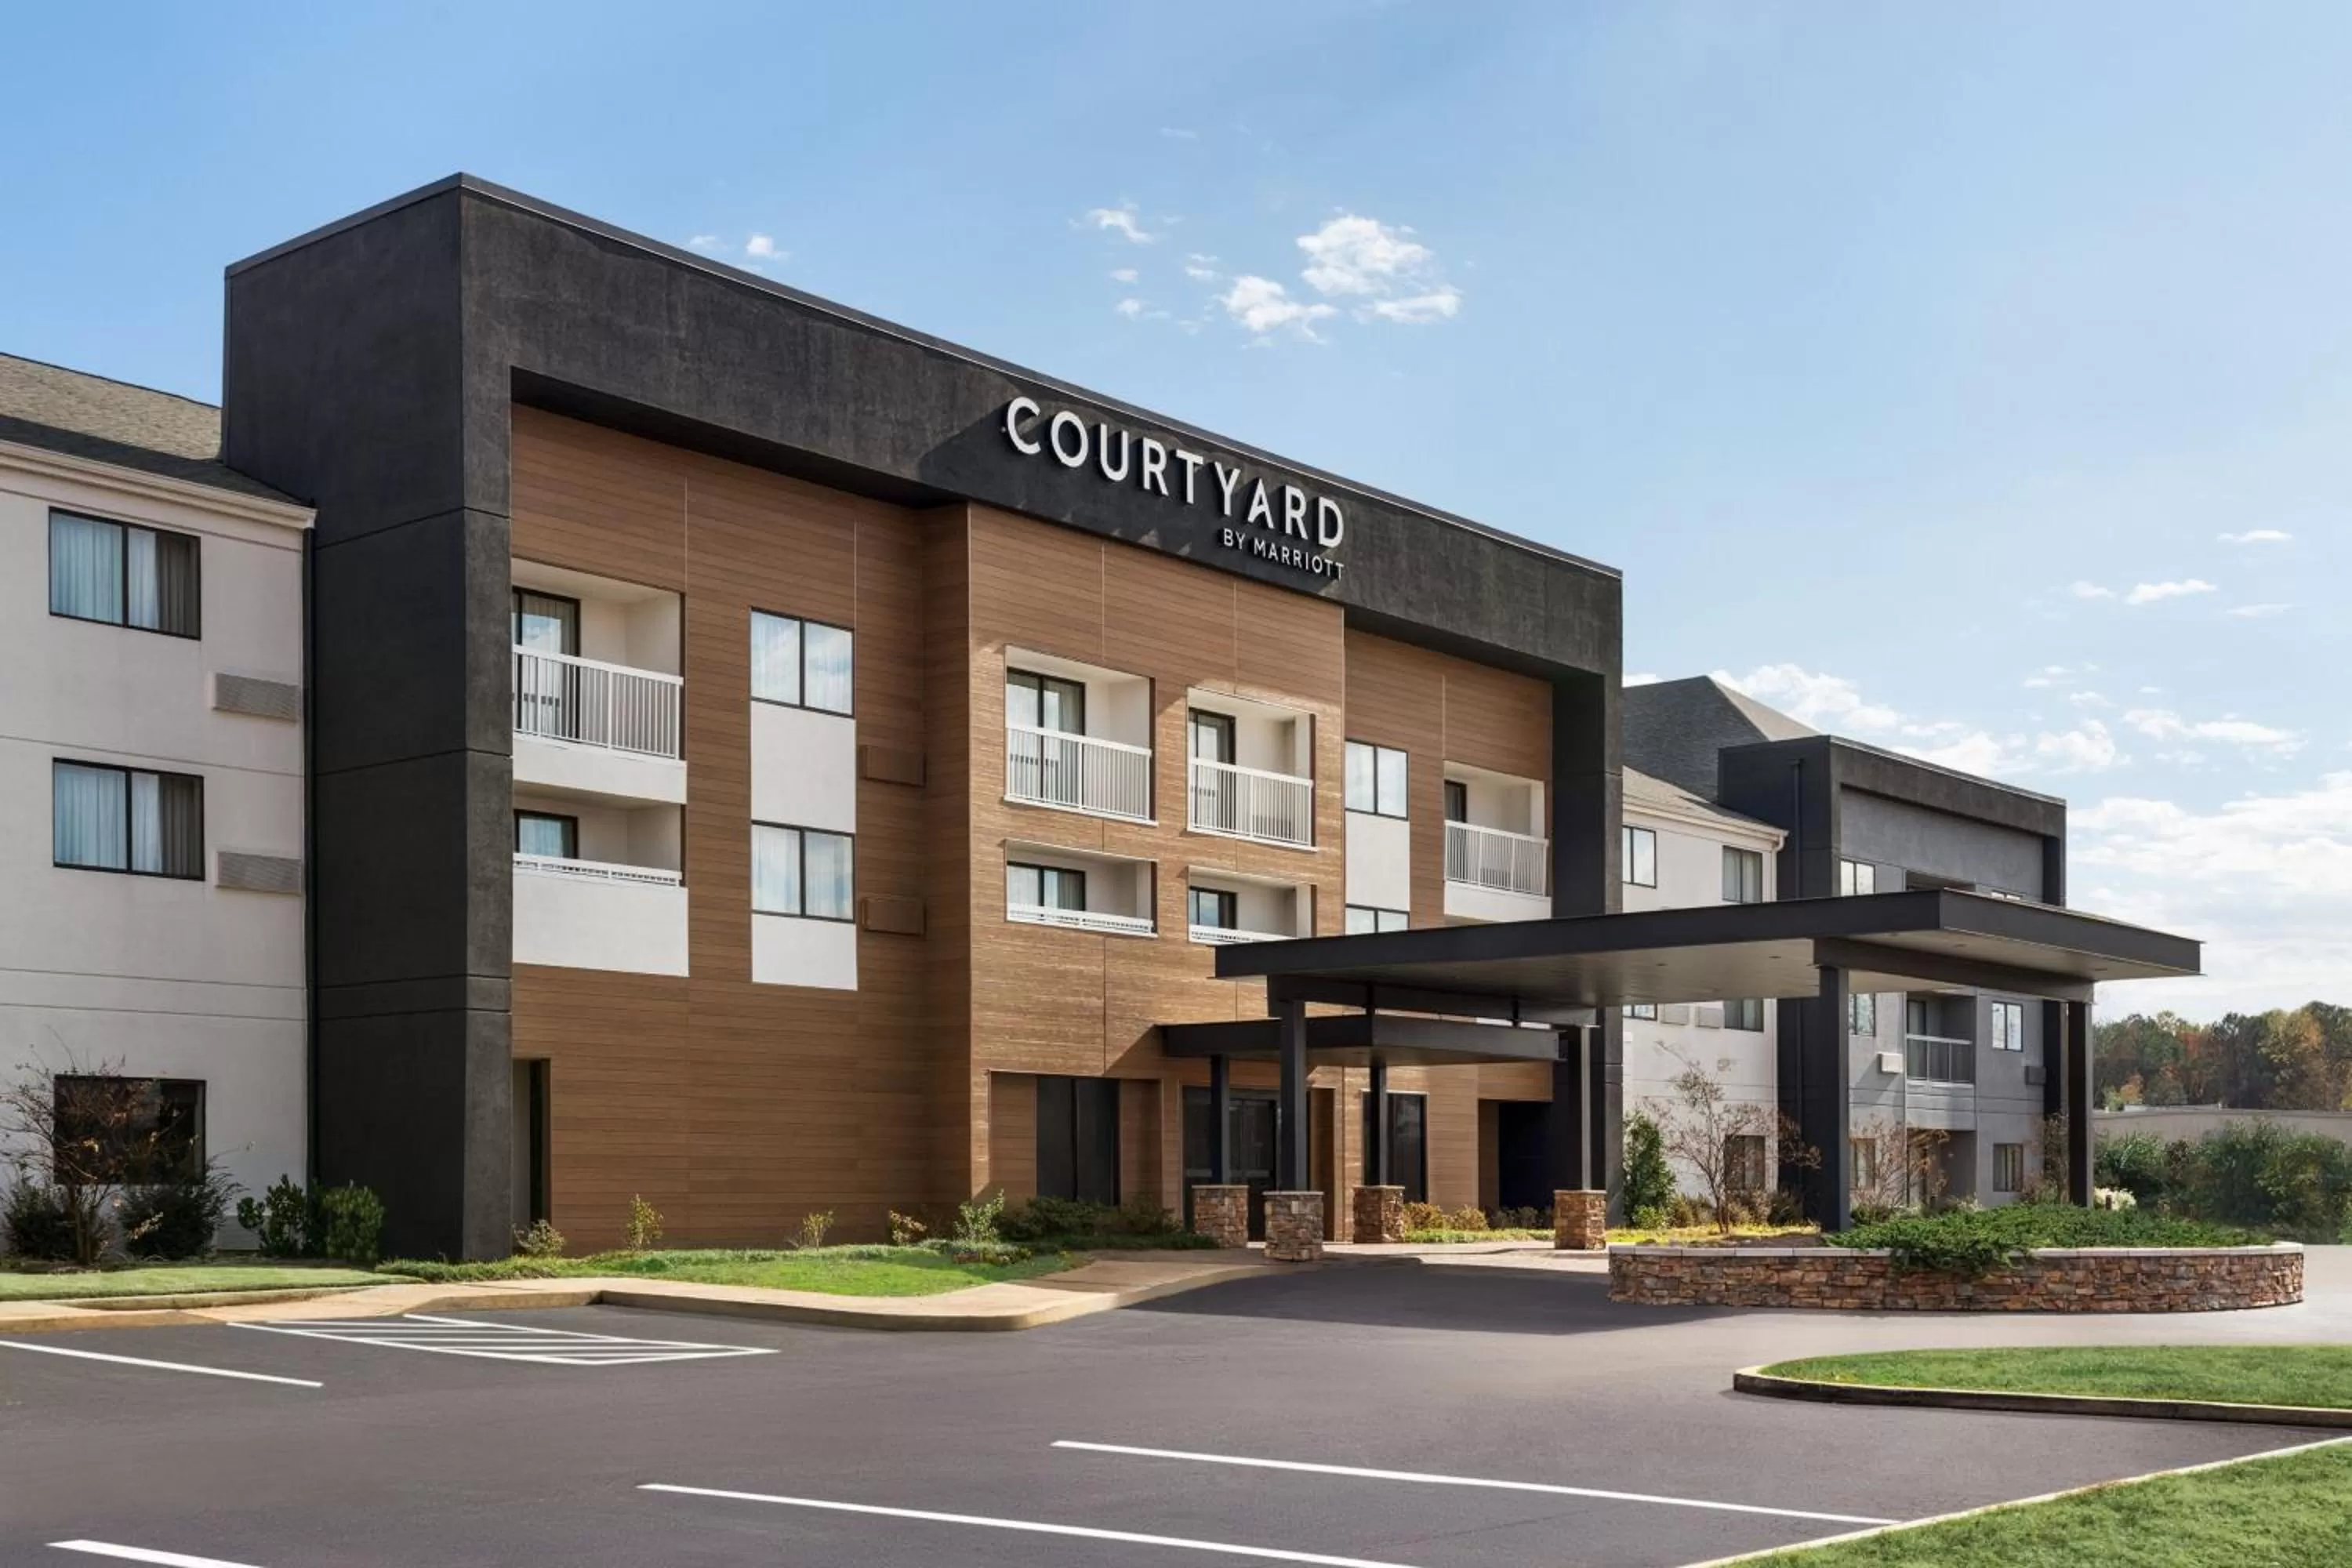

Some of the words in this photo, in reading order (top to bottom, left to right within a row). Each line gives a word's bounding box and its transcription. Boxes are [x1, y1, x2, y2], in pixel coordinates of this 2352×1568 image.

[1006, 397, 1345, 548] COURTYARD
[1223, 528, 1246, 550] BY
[1254, 538, 1345, 581] MARRIOTT
